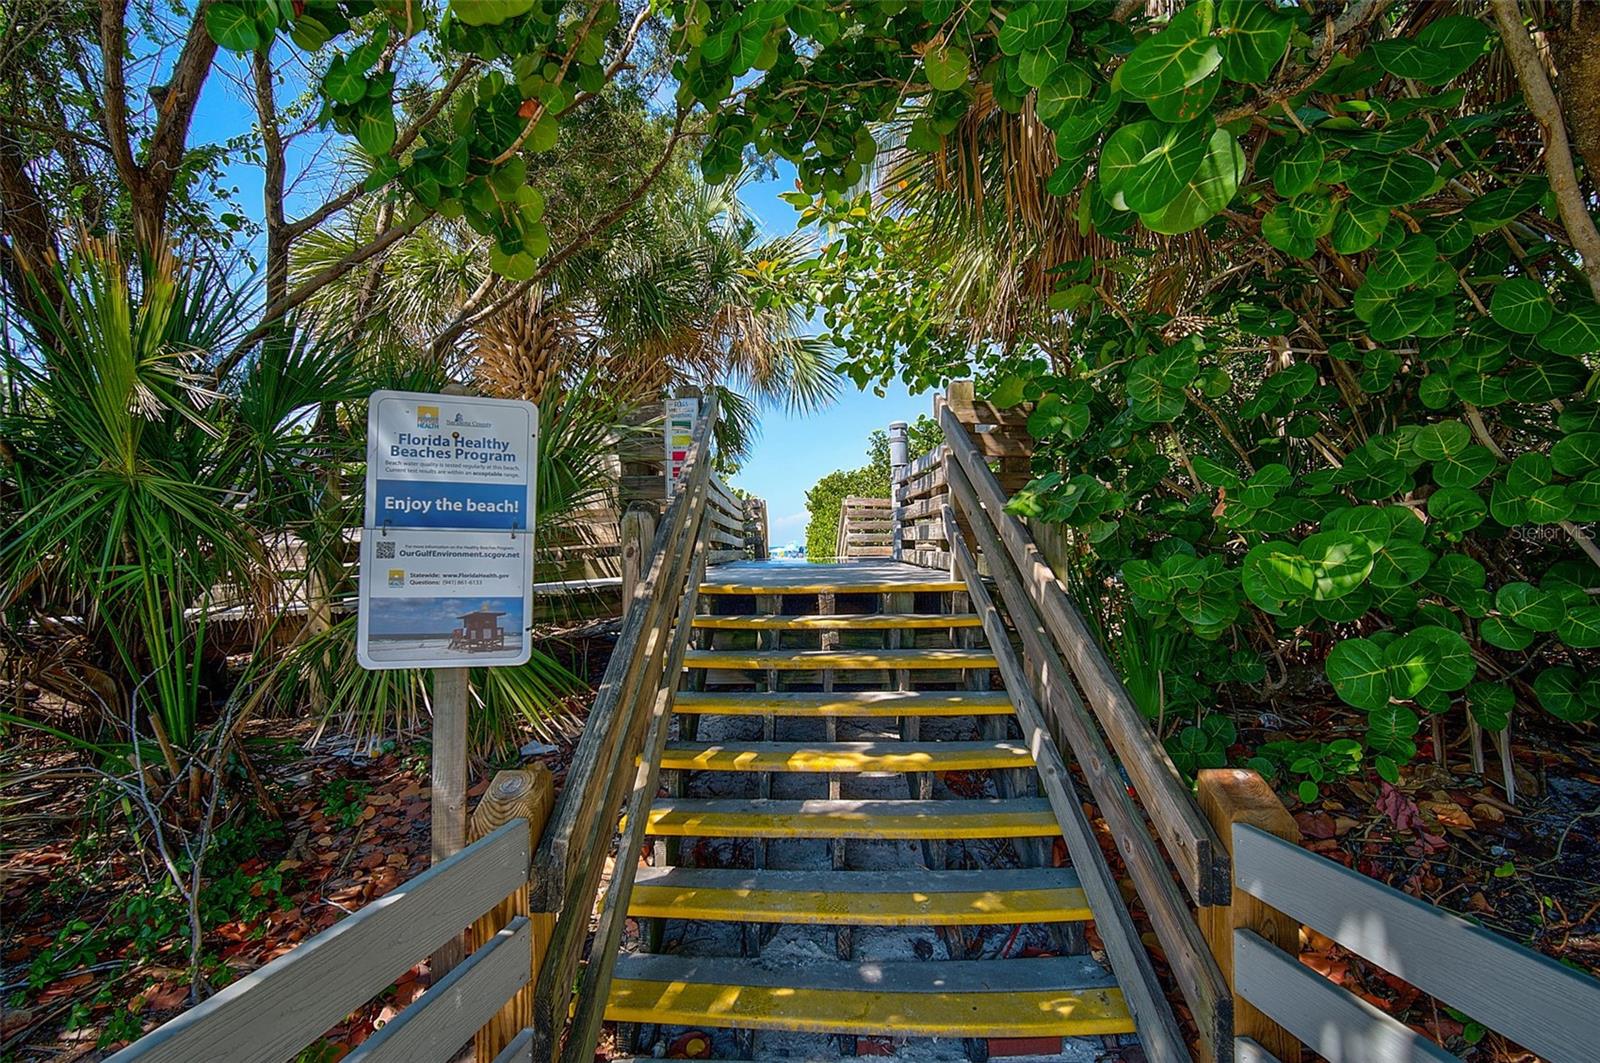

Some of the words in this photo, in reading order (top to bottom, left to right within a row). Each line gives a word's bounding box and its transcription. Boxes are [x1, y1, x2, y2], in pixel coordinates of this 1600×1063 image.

[398, 433, 450, 447] Florida
[454, 437, 510, 452] Healthy
[390, 445, 452, 459] Beaches
[455, 448, 516, 464] Program
[384, 496, 432, 513] Enjoy
[436, 498, 462, 511] the
[467, 499, 519, 513] beach!
[399, 549, 520, 559] OurGulfEnvironment.scgov.net
